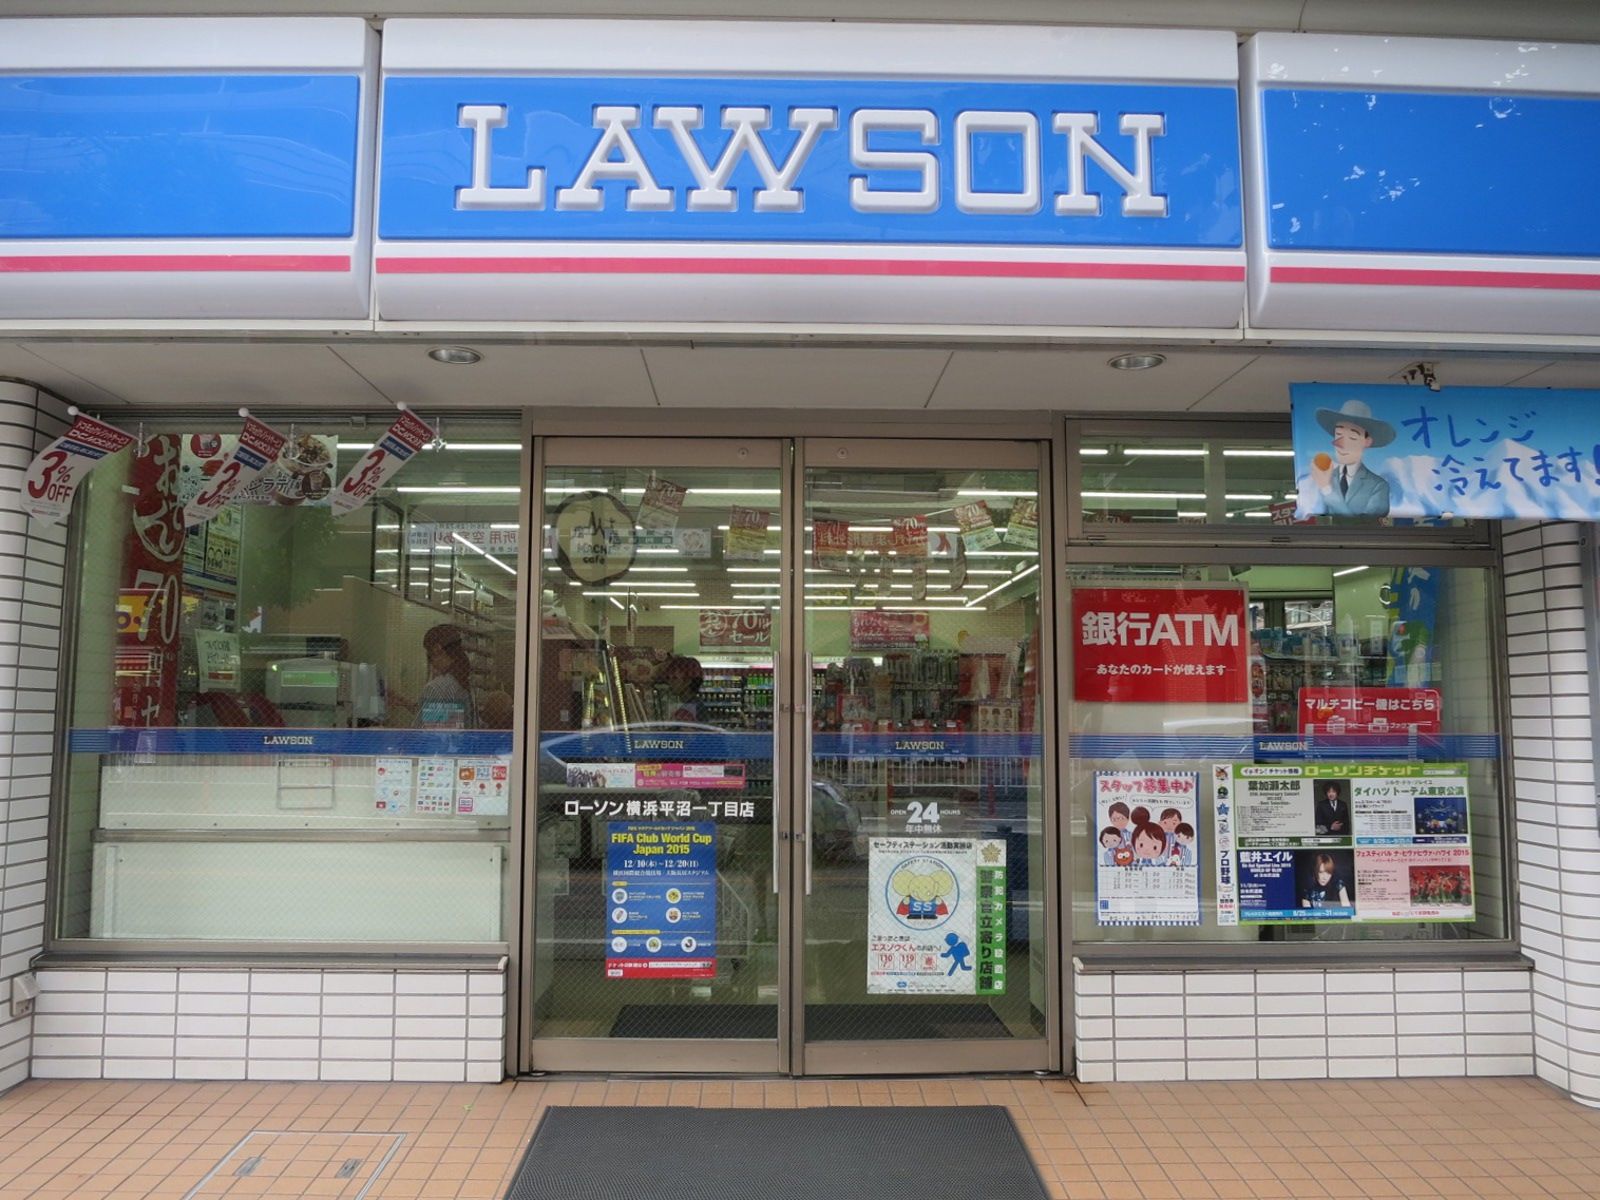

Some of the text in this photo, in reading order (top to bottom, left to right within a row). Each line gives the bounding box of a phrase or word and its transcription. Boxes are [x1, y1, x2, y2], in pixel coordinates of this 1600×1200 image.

[456, 105, 1167, 217] LAWSON
[1401, 406, 1537, 449] オレンジ
[47, 484, 73, 503] OFF
[353, 482, 377, 500] OFF
[1081, 611, 1239, 646] 銀行ATM
[729, 630, 769, 643] セール
[1096, 663, 1227, 676] あなたのカードが使えます
[1305, 698, 1436, 711] マルチコピー機はこちら
[263, 735, 313, 745] LAWSON
[634, 740, 684, 749] LAWSON
[895, 741, 945, 750] LAWSON
[1259, 741, 1309, 751] LAWSON
[1304, 765, 1420, 776] ローソンチケット
[906, 801, 940, 824] 24
[905, 825, 942, 834] 年中無休
[611, 833, 712, 845] FIFA Club World Cup
[633, 844, 690, 856] Japan 2015
[1452, 849, 1470, 857] 2015
[1220, 850, 1231, 884] プロ野球
[879, 954, 893, 962] 110
